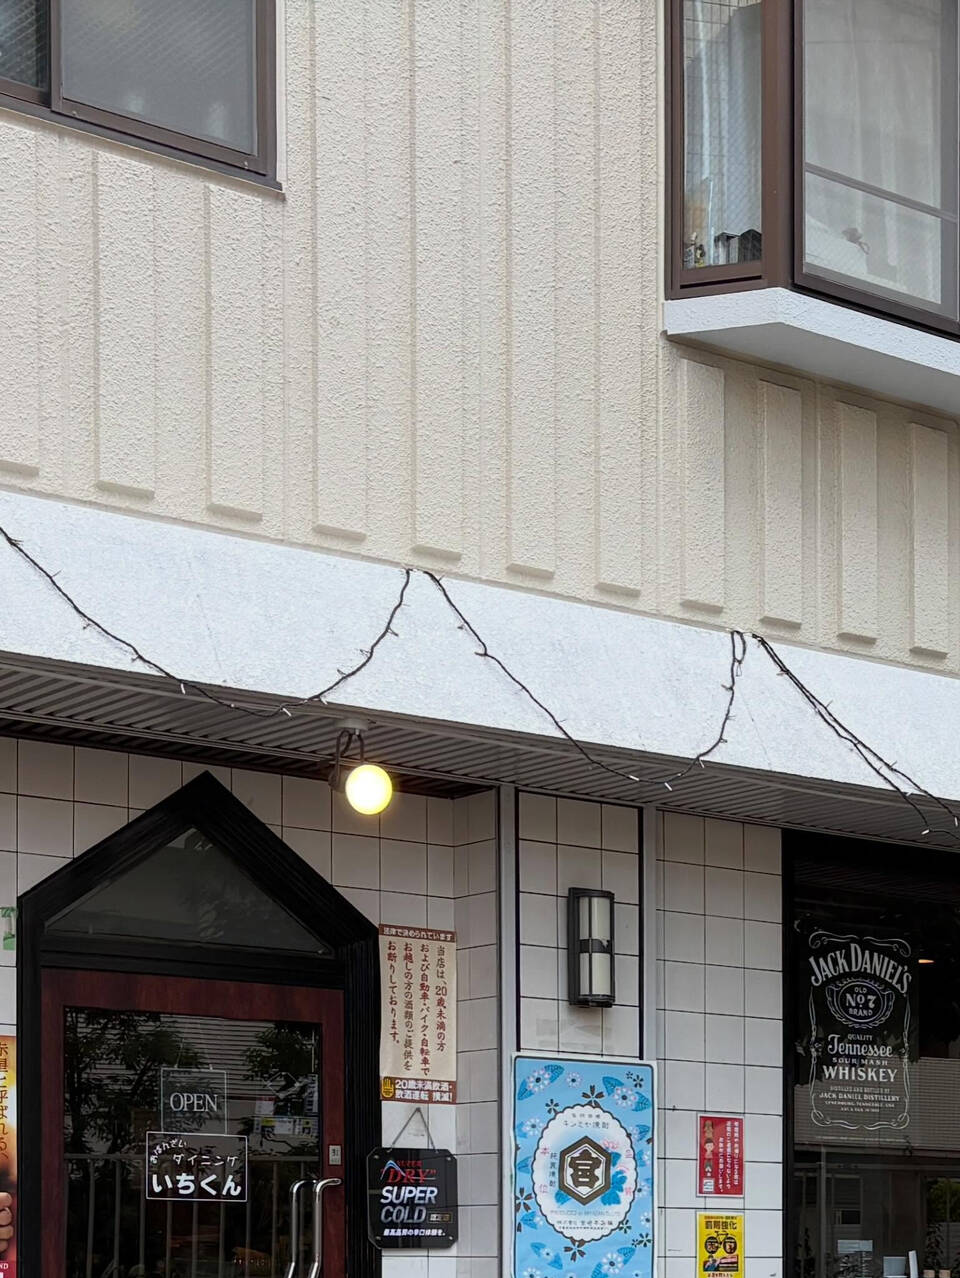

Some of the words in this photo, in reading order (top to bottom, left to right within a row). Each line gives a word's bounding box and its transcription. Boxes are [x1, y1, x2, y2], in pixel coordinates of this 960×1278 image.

[808, 949, 847, 987] JACK
[850, 943, 912, 996] DANIEL'S
[854, 986, 867, 994] OLD
[849, 1008, 873, 1017] BRAND
[828, 1034, 893, 1057] Tennessee
[847, 1033, 873, 1042] QUALITY
[832, 1057, 857, 1065] SOUR
[862, 1057, 888, 1066] MASH
[822, 1065, 898, 1082] WHISKEY
[170, 1092, 218, 1113] OPEN
[173, 1153, 238, 1167] ダイニング
[152, 1172, 242, 1196] いちくん
[380, 1186, 438, 1204] SUPER
[380, 1206, 427, 1223] COLD
